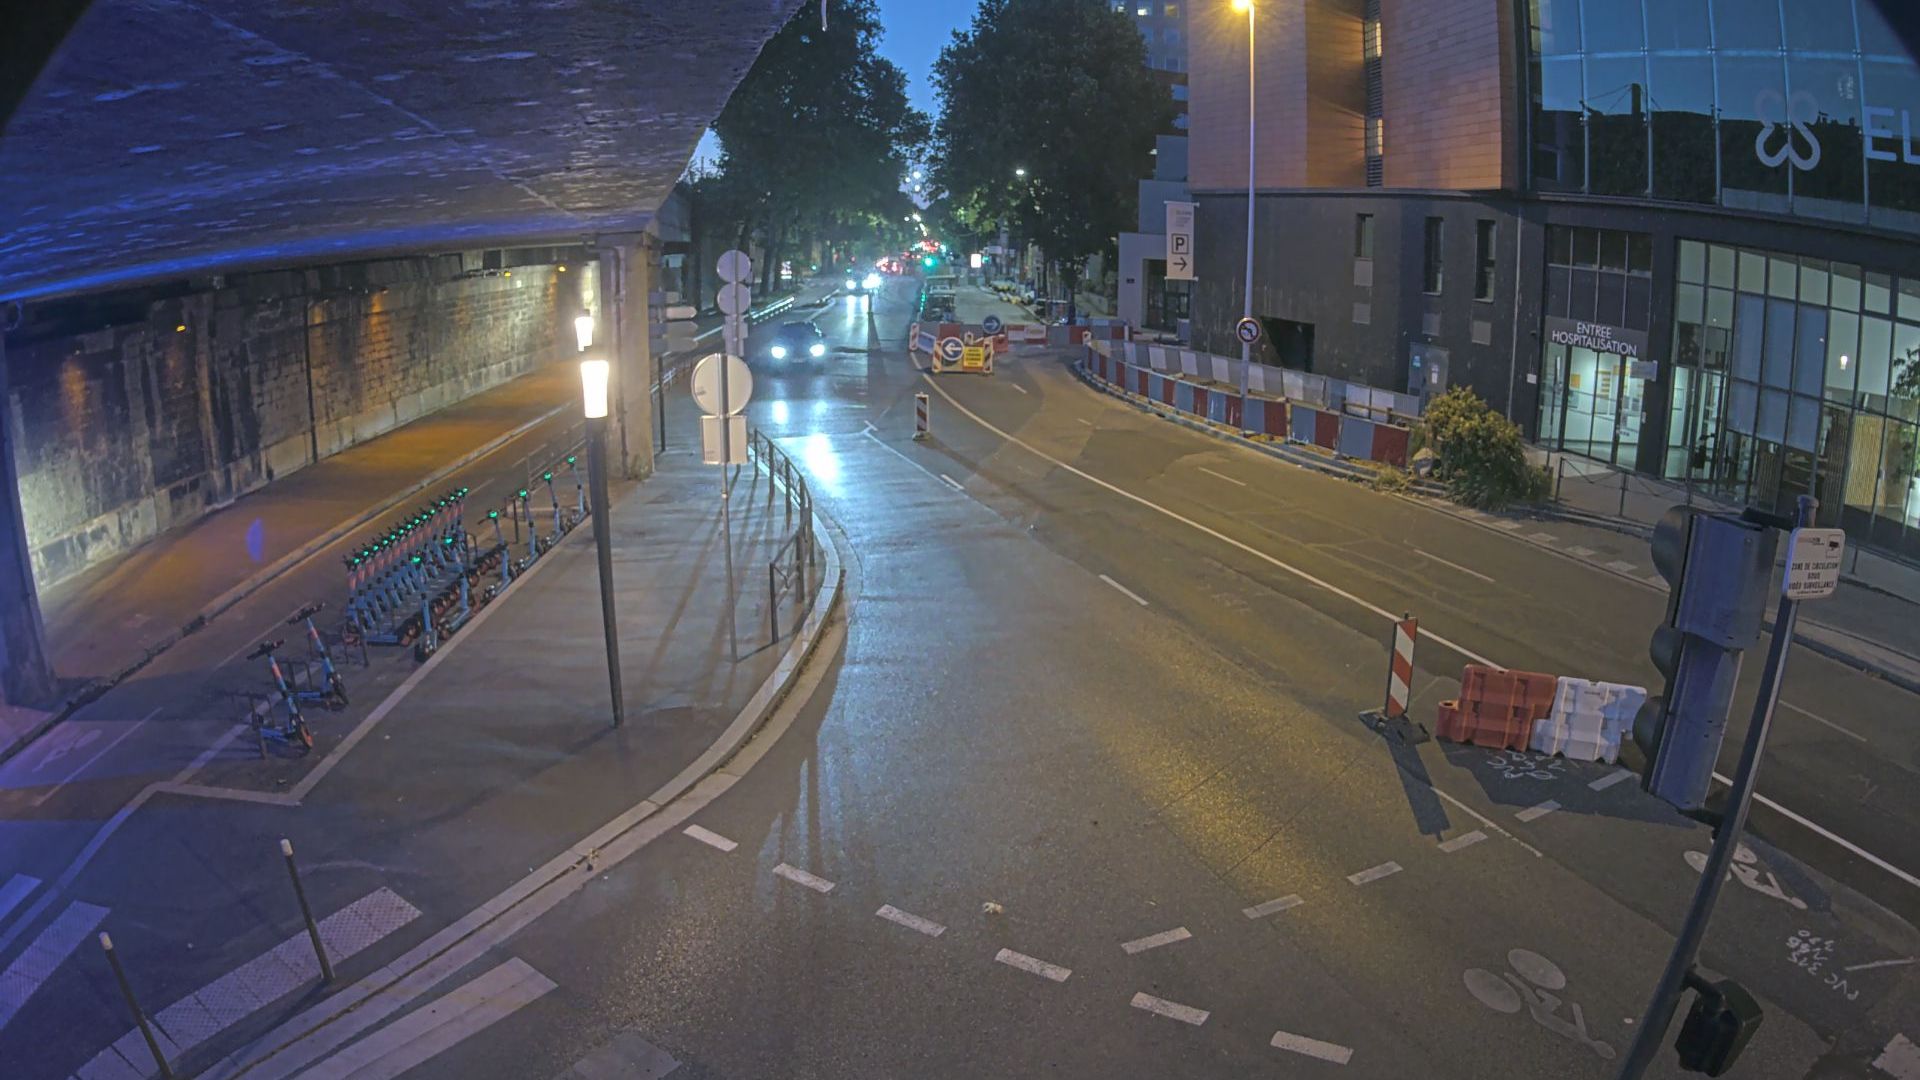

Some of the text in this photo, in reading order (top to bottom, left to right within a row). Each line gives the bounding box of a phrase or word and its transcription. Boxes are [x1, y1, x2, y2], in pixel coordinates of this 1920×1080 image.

[1863, 105, 1920, 165] EL
[1175, 236, 1185, 251] P
[1551, 330, 1637, 356] HOSPITALISATION
[1576, 322, 1612, 339] ENTREE
[1824, 973, 1860, 1001] PVC
